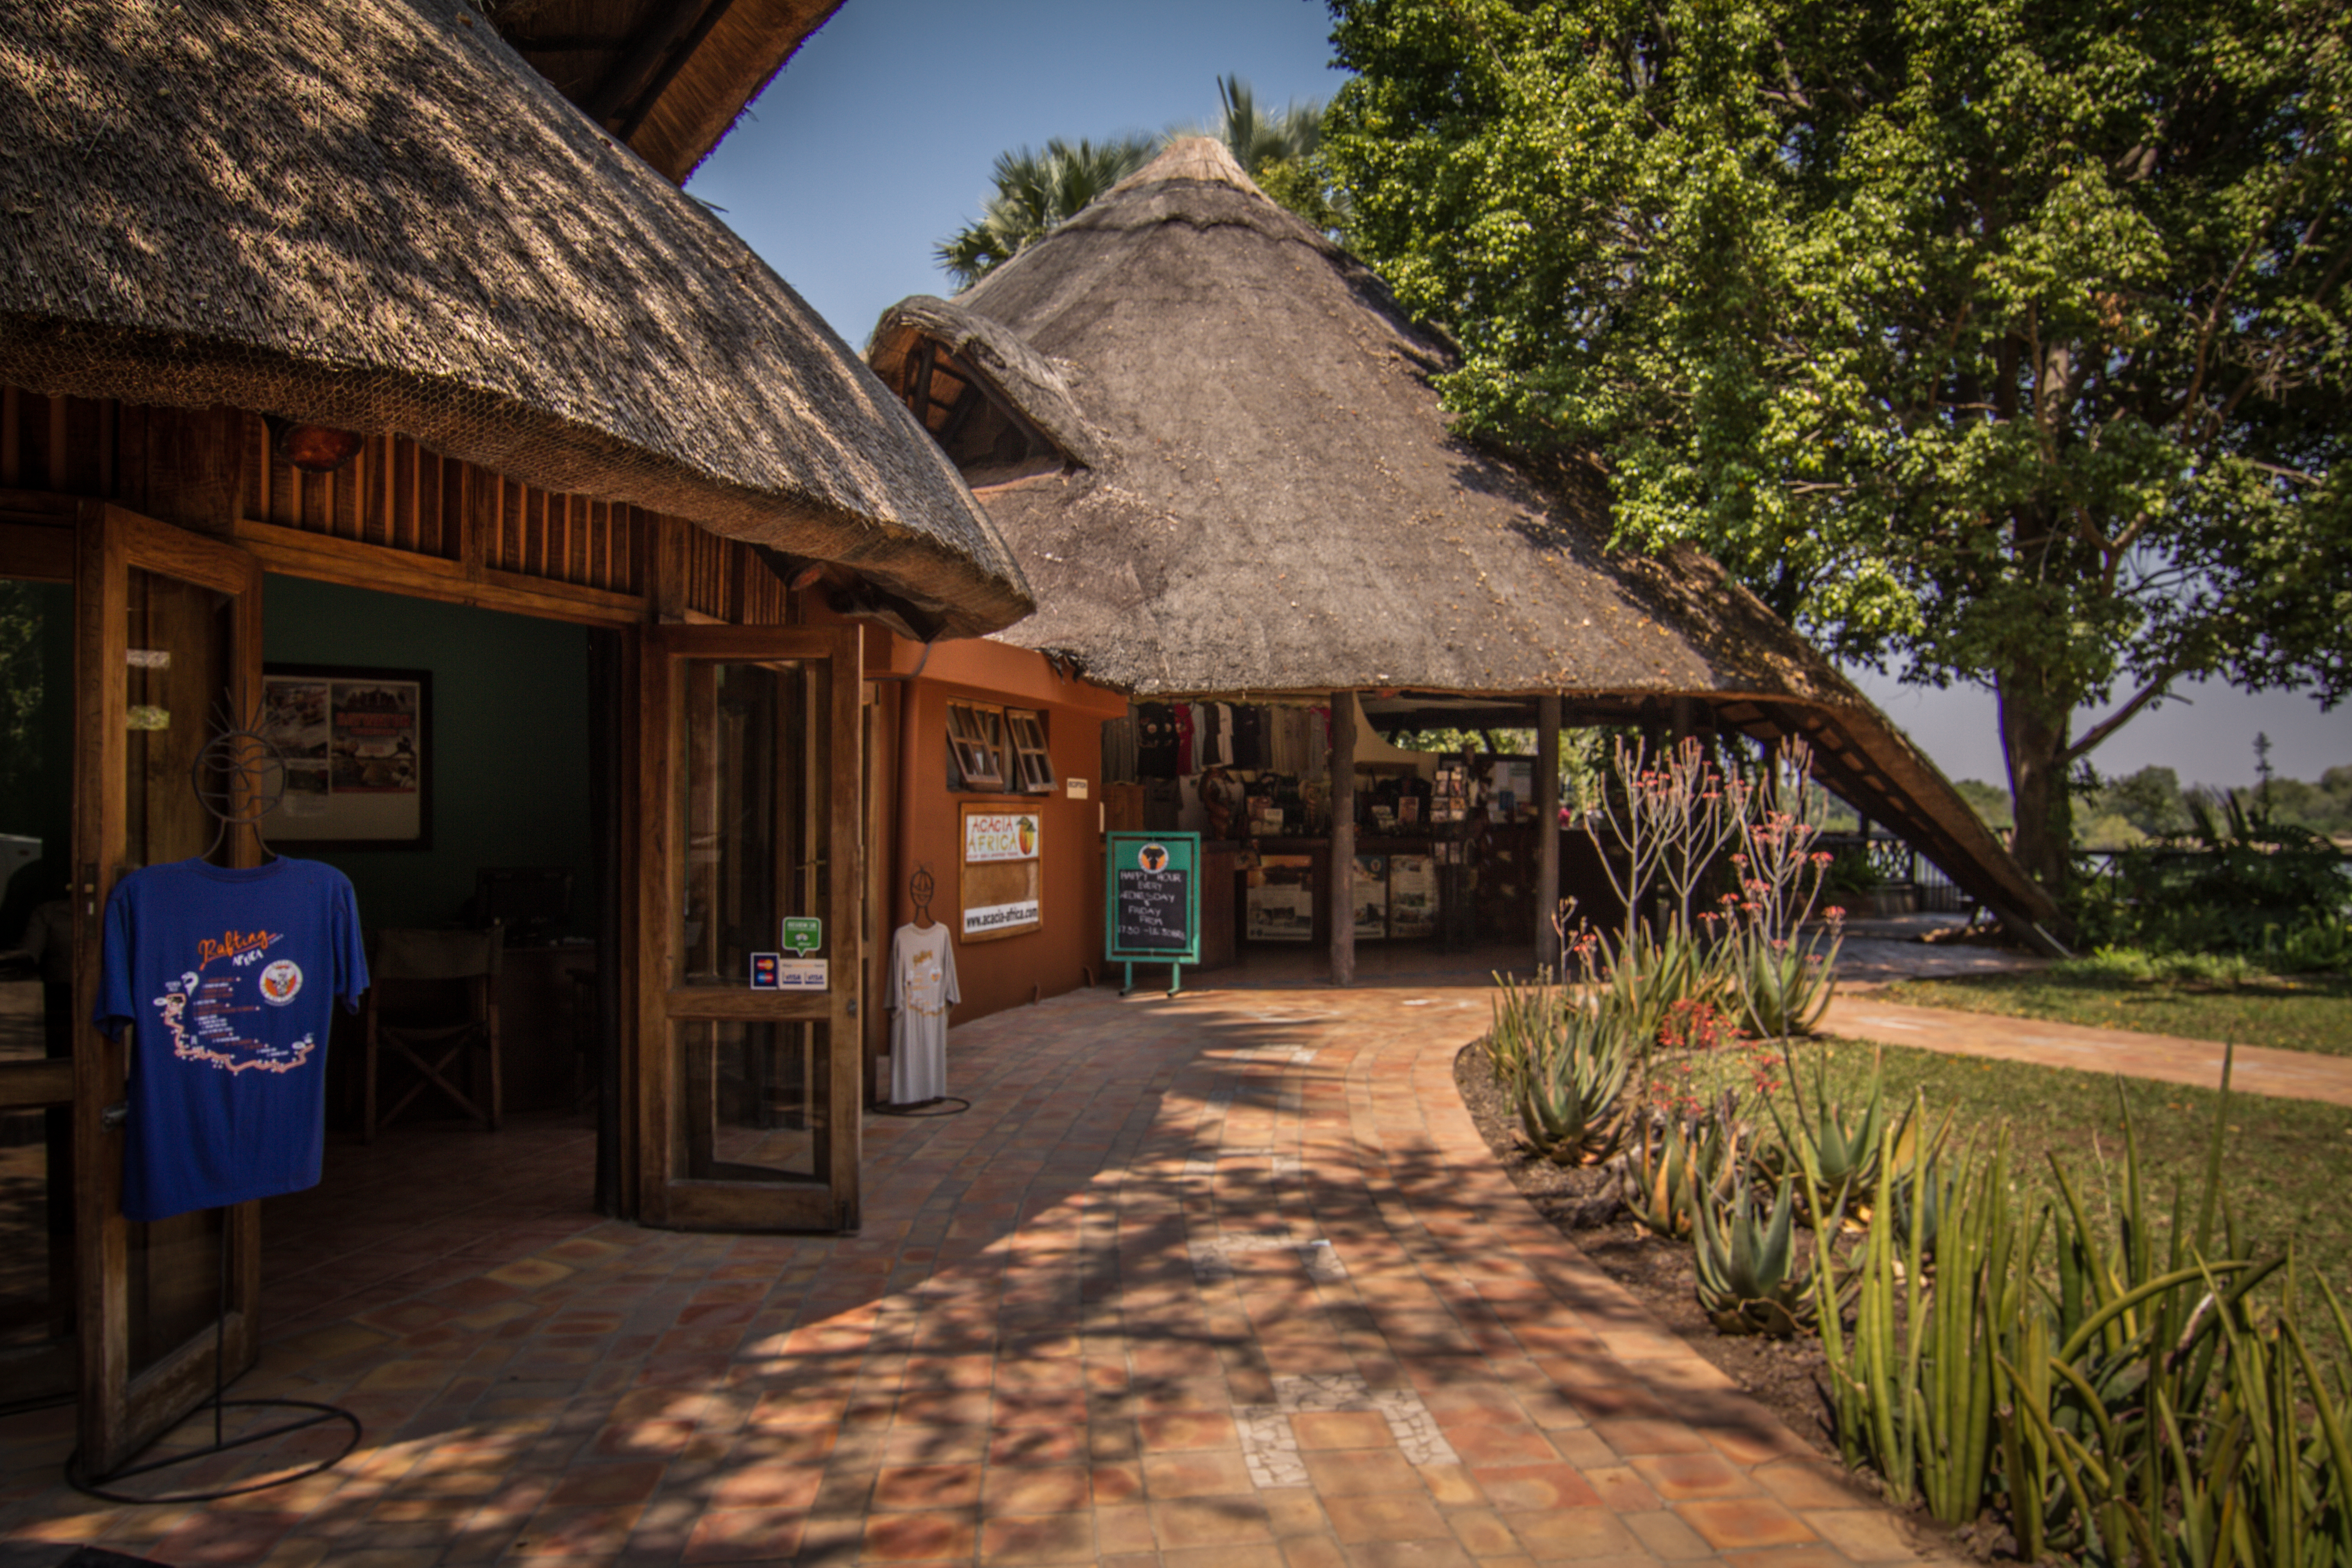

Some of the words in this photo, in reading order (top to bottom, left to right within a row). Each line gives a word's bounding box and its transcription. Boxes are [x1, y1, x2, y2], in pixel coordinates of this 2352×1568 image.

[972, 817, 1013, 833] ACACIA
[967, 833, 1018, 852] AFRICA
[1120, 871, 1147, 881] HAPPY
[1156, 872, 1181, 882] HOUR
[1137, 881, 1162, 892] EVERY
[966, 907, 1037, 927] www.acacia-africa.com
[1128, 905, 1161, 917] FRIDAY
[1139, 915, 1163, 926] FROM
[198, 930, 268, 965] Rafting
[232, 949, 264, 966] AFRICA
